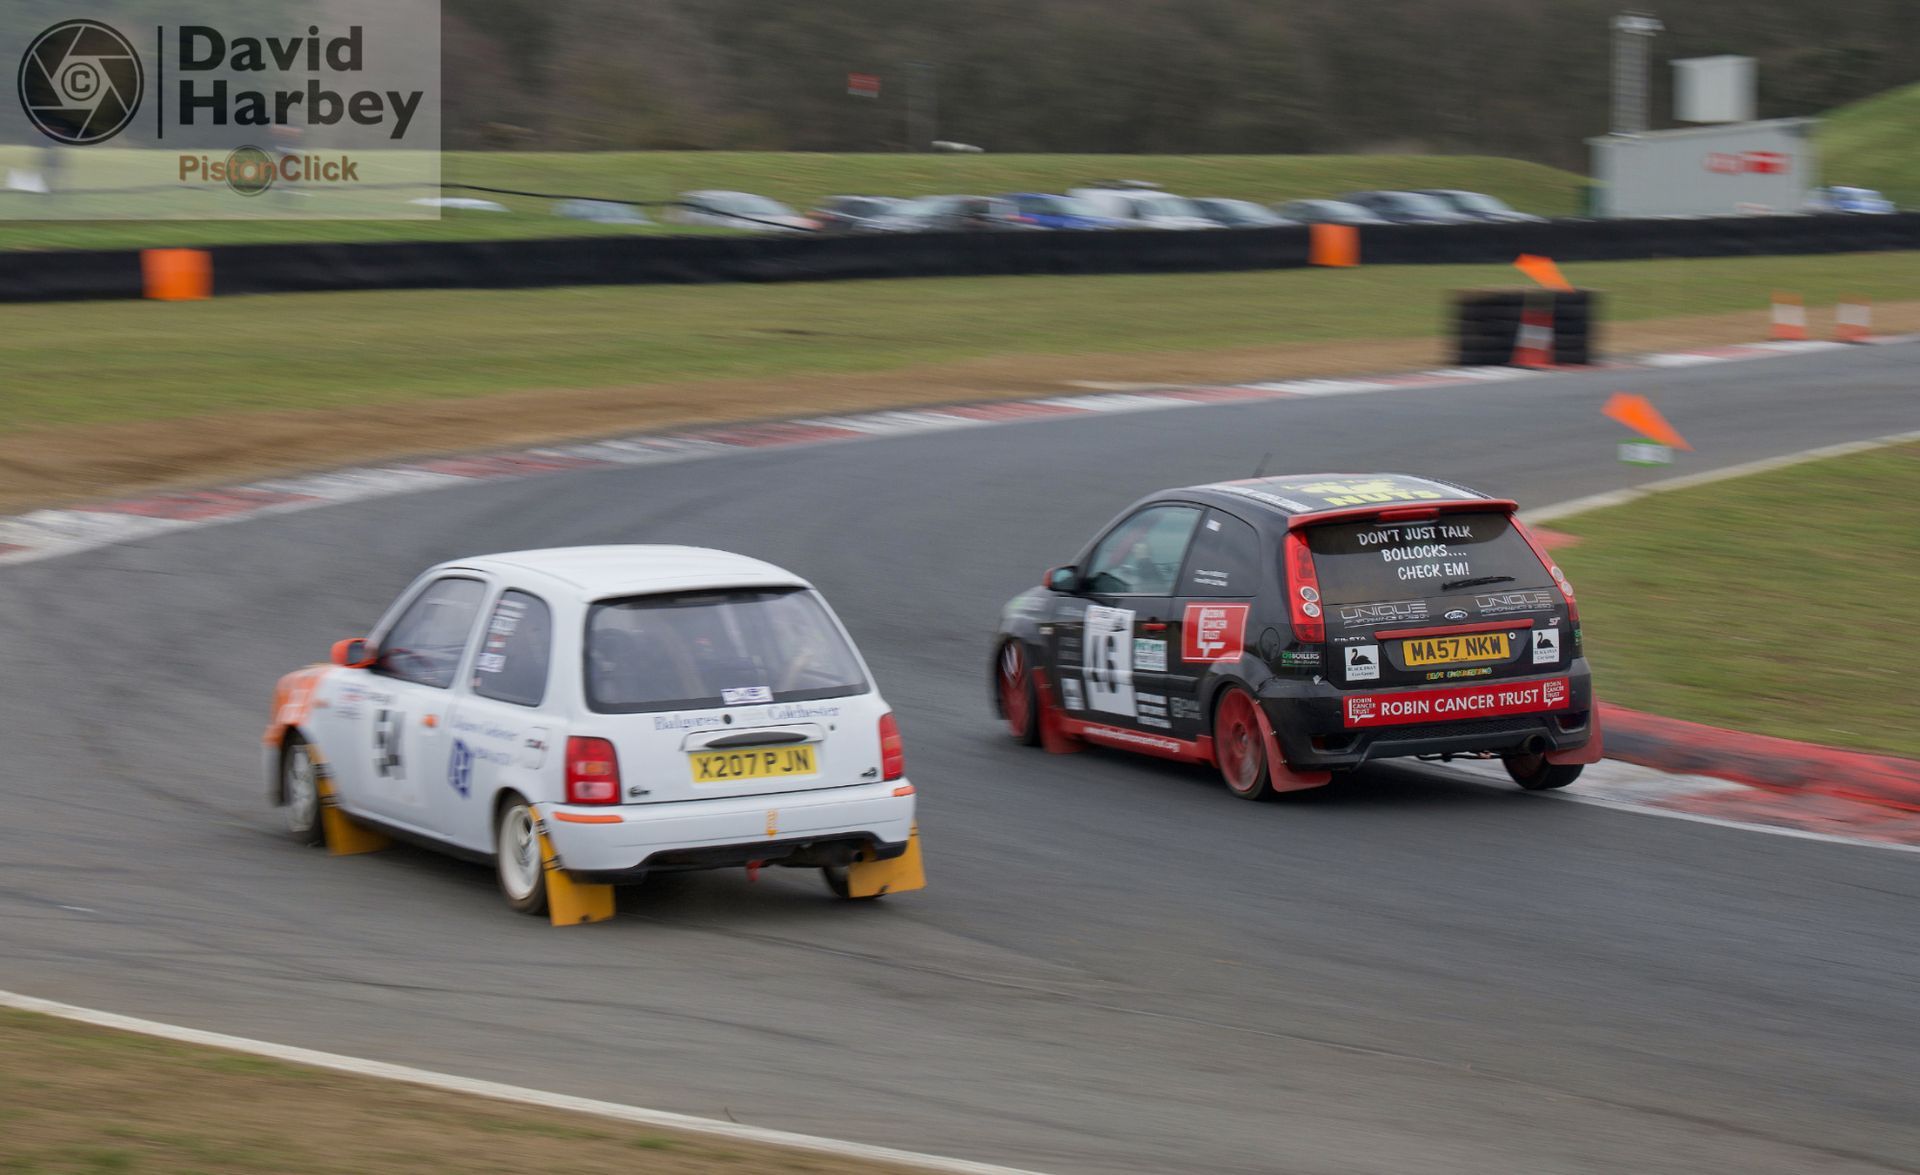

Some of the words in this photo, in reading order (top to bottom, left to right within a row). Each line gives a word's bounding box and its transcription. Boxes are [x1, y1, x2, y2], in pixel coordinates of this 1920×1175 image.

[1357, 528, 1400, 547] DON'T
[1404, 526, 1437, 542] JUST
[1439, 525, 1473, 540] TALK
[1397, 564, 1441, 581] CHECK
[1445, 562, 1471, 577] EM!
[1340, 600, 1428, 619] UNIQUE
[1475, 591, 1553, 608] UNIQUE
[1411, 639, 1460, 662] MA57
[1465, 636, 1502, 657] NKW
[1381, 699, 1430, 717] ROBIN
[1434, 695, 1494, 713] CANCER
[1498, 689, 1540, 708] TRUST
[696, 753, 758, 779] X207
